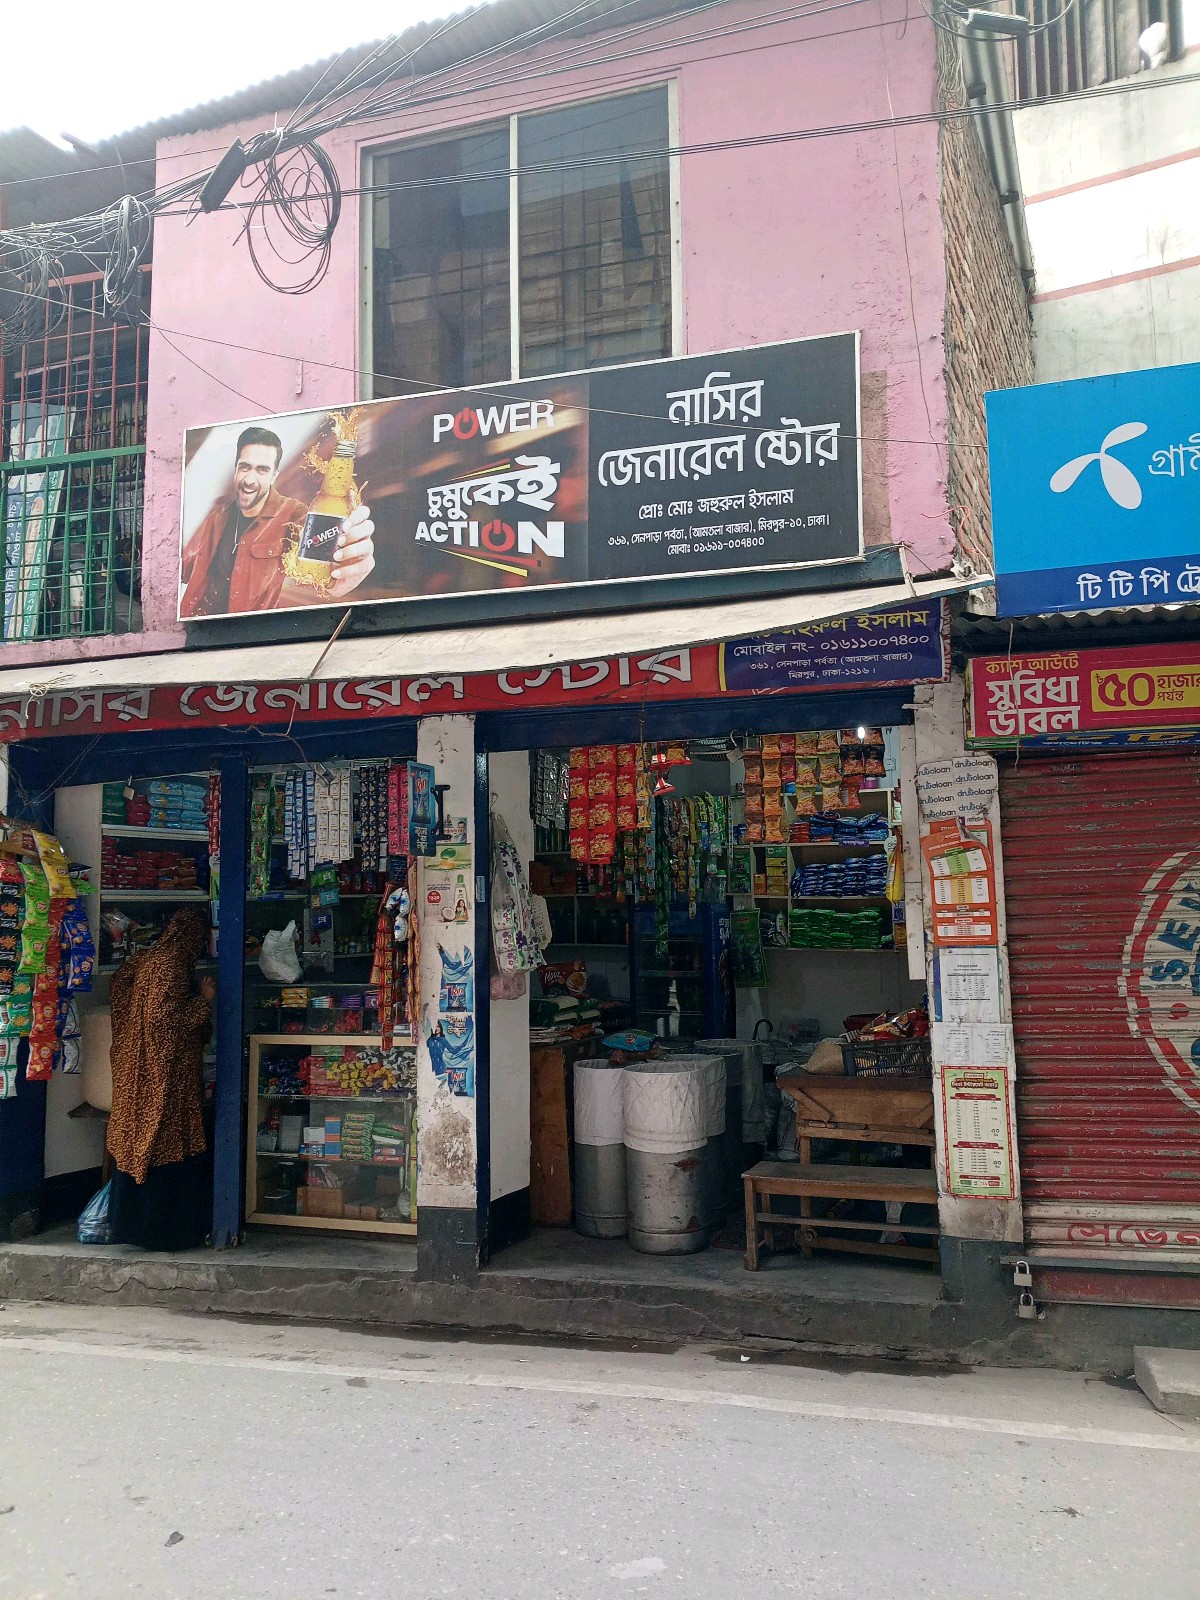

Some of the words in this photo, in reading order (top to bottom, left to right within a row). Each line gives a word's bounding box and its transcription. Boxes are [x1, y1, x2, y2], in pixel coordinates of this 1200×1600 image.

[666, 372, 764, 426] নাসির
[433, 400, 554, 443] POWER
[598, 435, 746, 487] জেনারেল
[755, 417, 841, 468] ষ্টোর
[427, 455, 561, 520] চুমুকেই
[697, 494, 745, 514] জহুরুল
[748, 488, 794, 509] ইসলাম
[307, 526, 340, 548] POWER
[415, 519, 565, 558] ACTION
[631, 531, 663, 544] সেনপাড়া
[689, 523, 724, 539] (আমতলা
[693, 537, 765, 553] ০১৬১১-০০৭৪০০
[1076, 573, 1103, 601] টি
[1107, 570, 1135, 598] টি
[1139, 567, 1171, 596] পি
[855, 610, 930, 631] ইসলাম
[733, 643, 787, 657] মোবাইল
[820, 634, 930, 651] ০১৬১১০০৭৪০০
[776, 658, 811, 668] সেনপাড়া
[814, 656, 838, 666] পর্বতা
[985, 660, 1023, 674] ক্যাশ
[1027, 653, 1079, 671] আউটে
[985, 670, 1080, 711] সুবিধা
[1157, 688, 1185, 702] পর্যন্ত
[986, 706, 1081, 737] ডাবল
